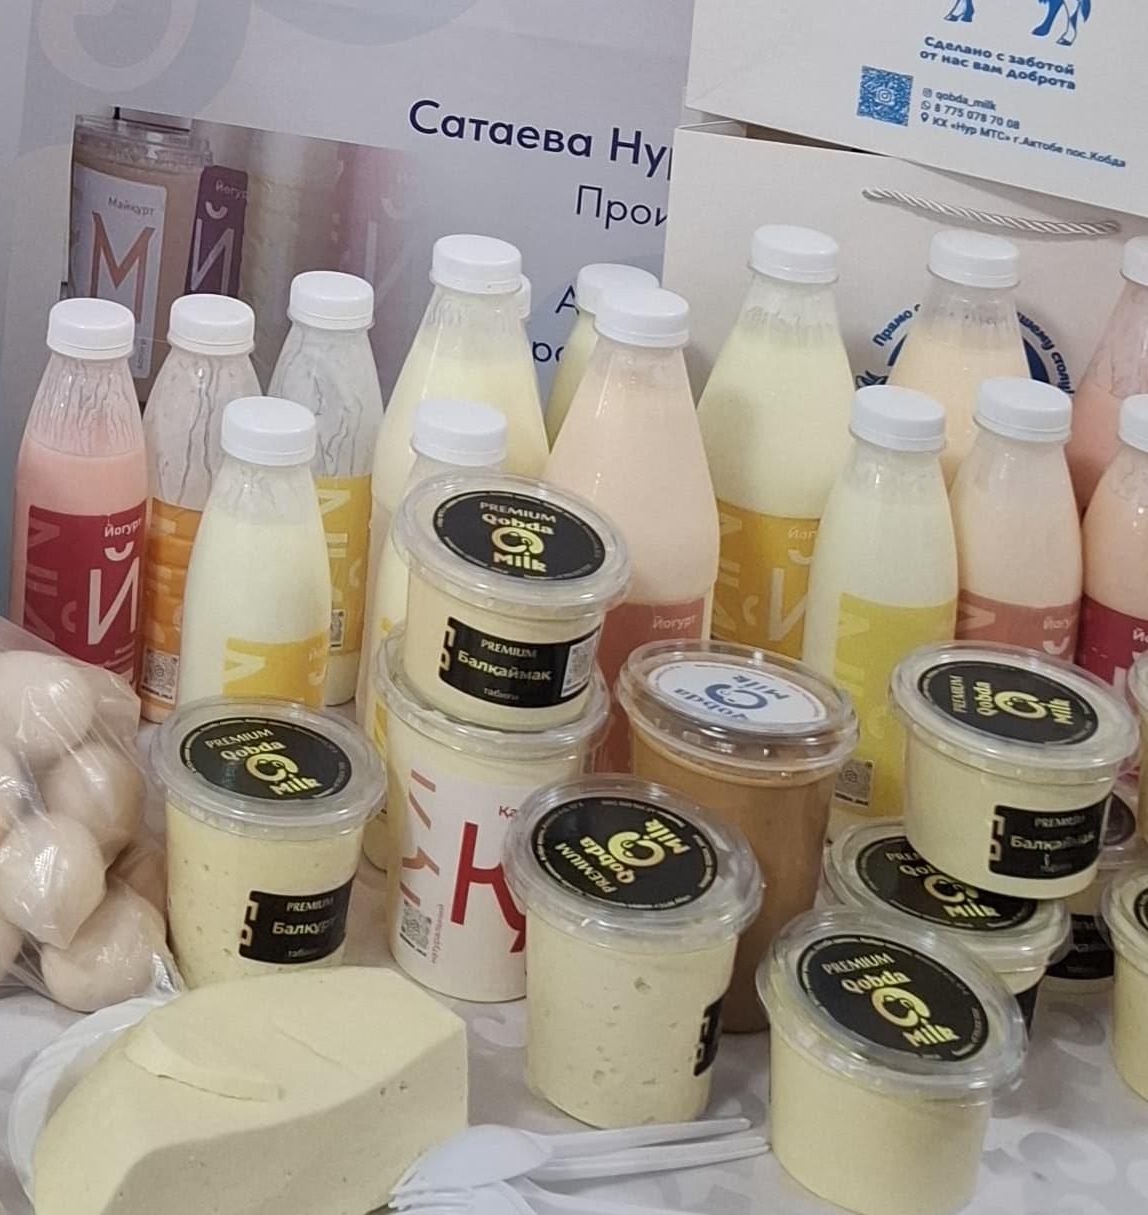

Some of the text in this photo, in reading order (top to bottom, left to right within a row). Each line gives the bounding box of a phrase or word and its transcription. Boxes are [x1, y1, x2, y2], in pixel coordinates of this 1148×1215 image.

[924, 36, 1075, 76] Сделано с заботой
[920, 50, 1076, 90] от нас вам доброта
[935, 90, 997, 110] qobda_milk
[944, 105, 964, 118] 775
[990, 115, 1003, 126] 70
[408, 98, 593, 158] Сатаева
[480, 501, 556, 523] PREMIUM
[482, 513, 555, 535] Qobda
[492, 551, 547, 572] Milk
[480, 638, 537, 658] PREMIUM
[205, 728, 274, 749] PREMIUM
[220, 740, 287, 761] Qobda
[645, 817, 692, 855] Milk
[555, 842, 617, 894] PREMIUM
[579, 835, 636, 884] Qobda
[822, 952, 895, 976] PREMIUM
[841, 970, 912, 995] Qobda
